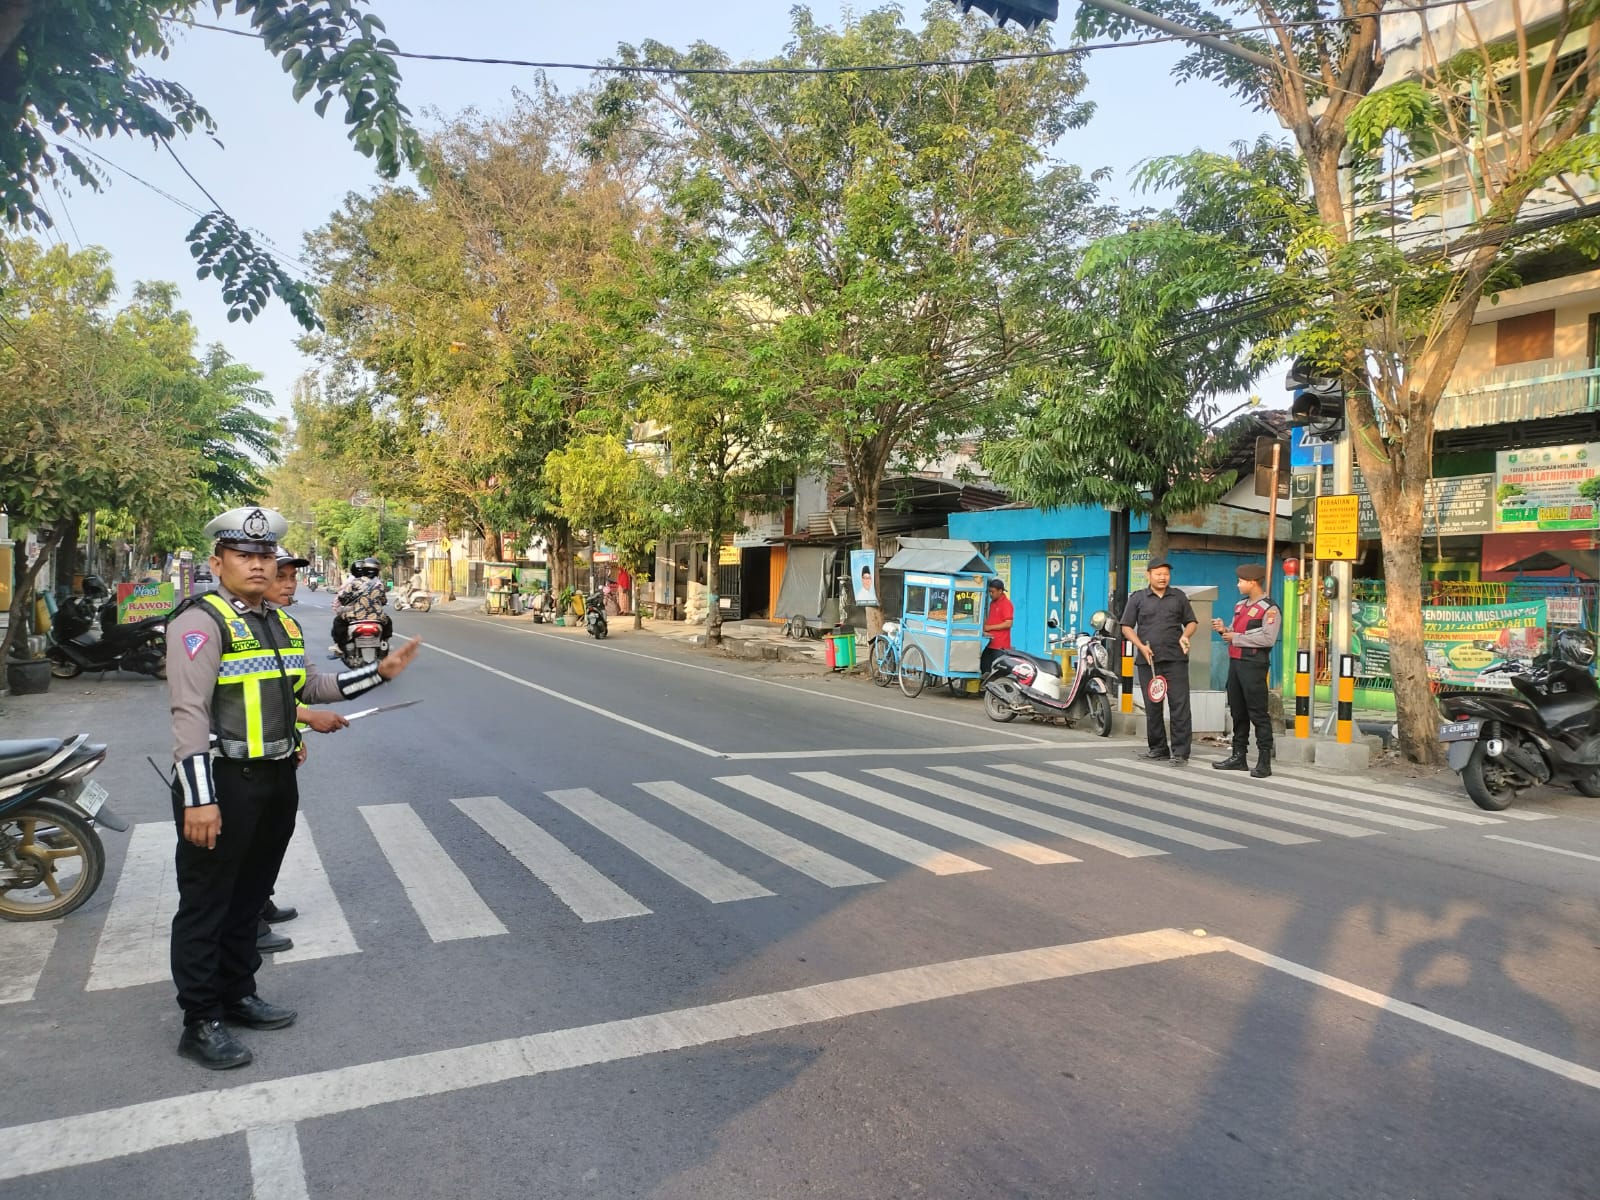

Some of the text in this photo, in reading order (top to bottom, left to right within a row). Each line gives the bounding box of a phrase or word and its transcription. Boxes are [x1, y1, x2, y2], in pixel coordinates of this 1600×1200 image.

[1530, 464, 1557, 472] PENDIDIKAN
[1557, 462, 1580, 470] MUSLIMAT
[1502, 474, 1524, 482] PAUD
[1525, 472, 1534, 482] AL
[1536, 469, 1583, 481] LATHIFIYAH
[134, 585, 160, 597] Nasi
[128, 602, 172, 610] RAWON
